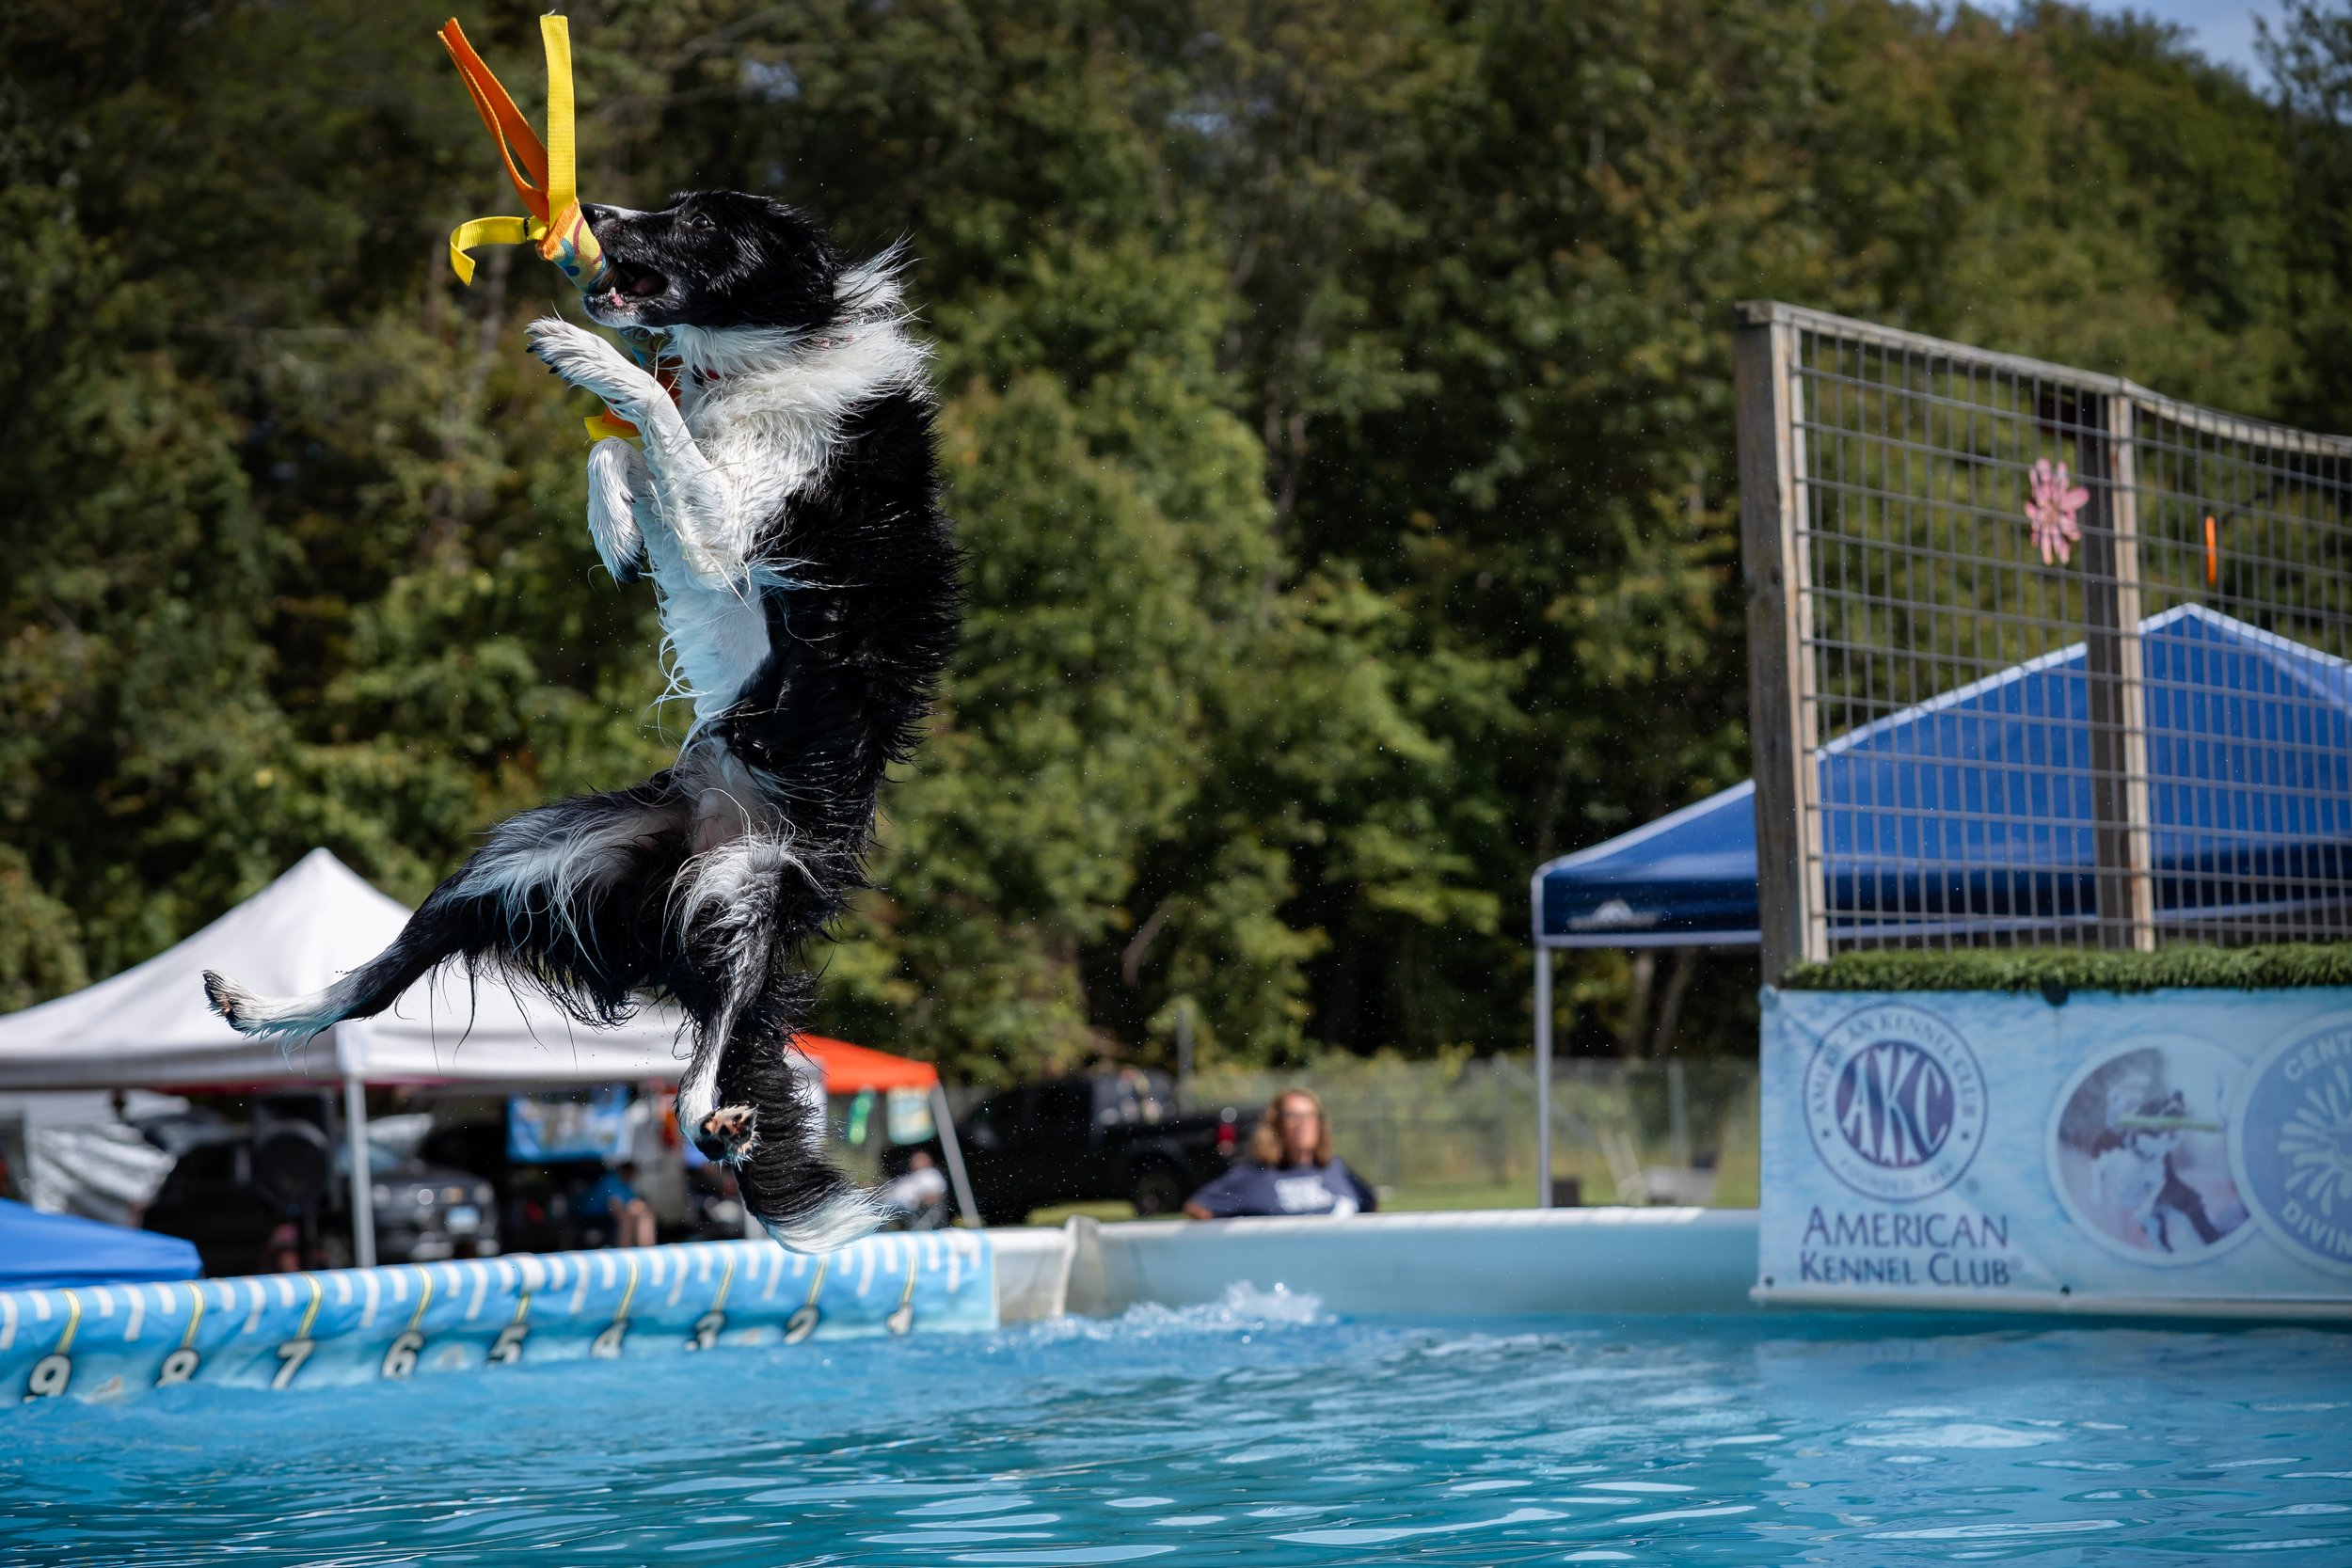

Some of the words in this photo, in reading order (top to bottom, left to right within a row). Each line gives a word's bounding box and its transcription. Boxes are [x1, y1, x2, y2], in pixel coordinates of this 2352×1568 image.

[1840, 1044, 1949, 1164] AKC
[1880, 1012, 1955, 1057] KENNEL
[1951, 1058, 1978, 1118] CLUB
[1800, 1250, 1919, 1286] KENNEL
[1929, 1252, 2011, 1288] CLUB
[1802, 1205, 2009, 1249] AMERICAN
[22, 1353, 72, 1403] 9
[269, 1338, 315, 1390] 7
[380, 1329, 423, 1379] 6
[486, 1323, 530, 1368] 5
[589, 1319, 631, 1359] 4
